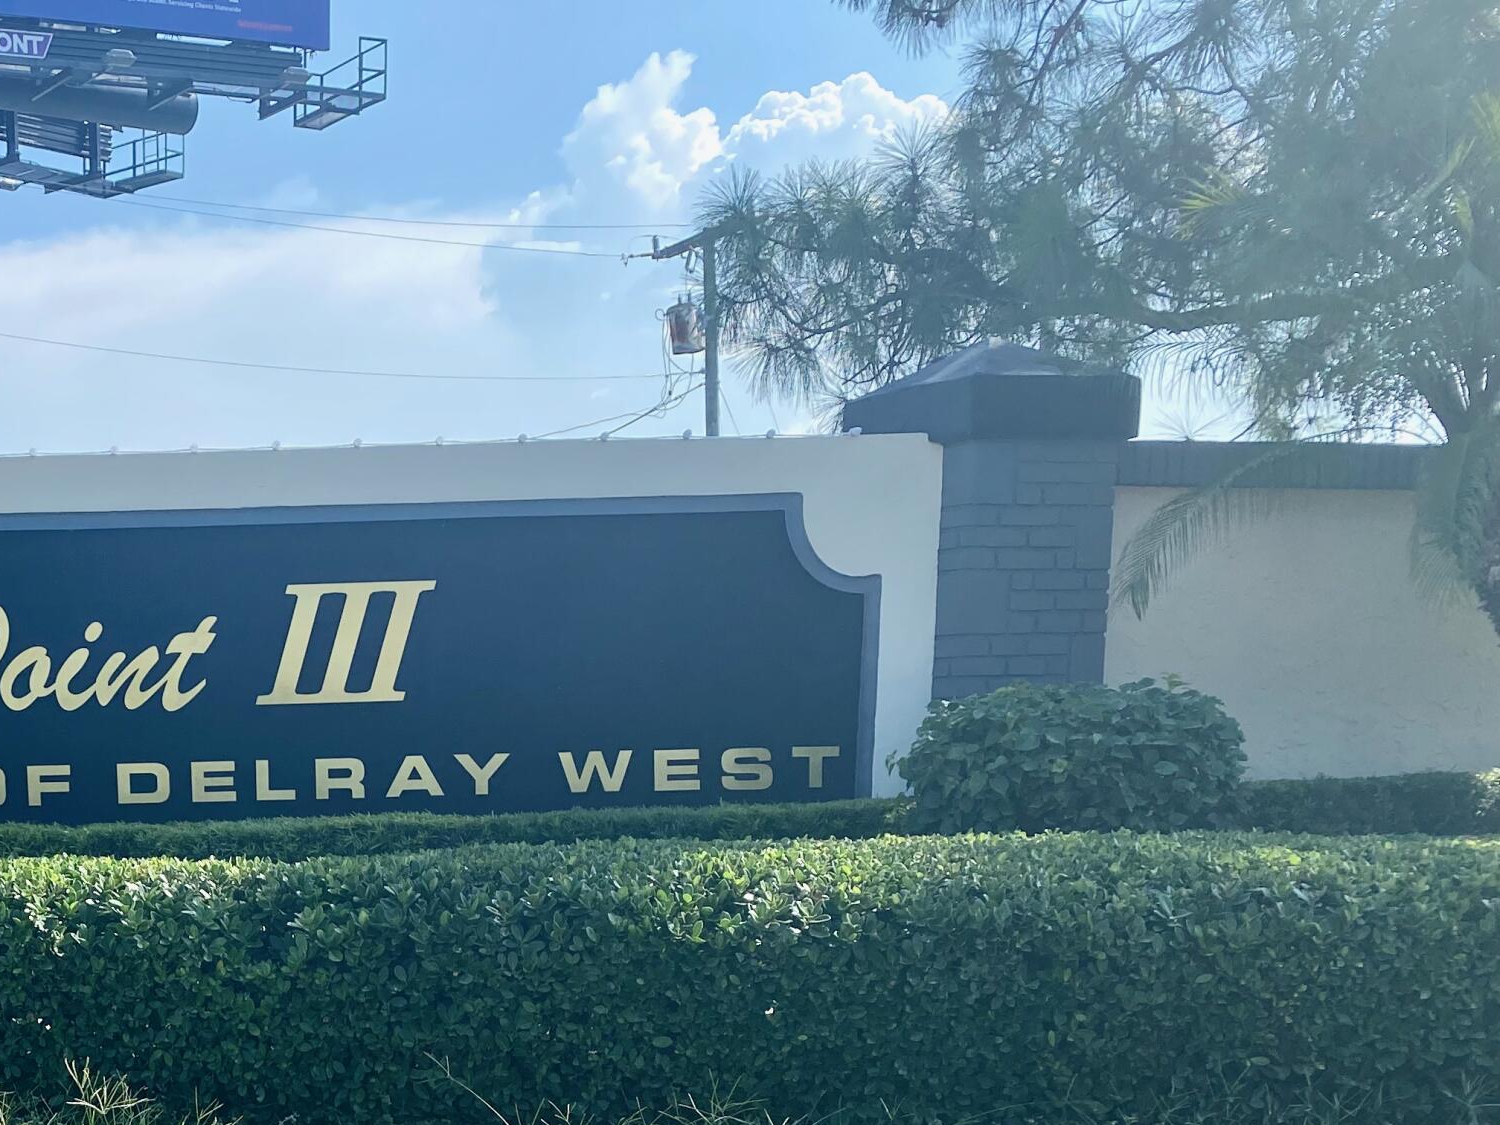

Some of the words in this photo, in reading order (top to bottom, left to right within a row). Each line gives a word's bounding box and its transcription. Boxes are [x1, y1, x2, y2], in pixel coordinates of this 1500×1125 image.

[256, 580, 437, 706] III
[116, 754, 511, 804] DELRAY
[559, 744, 842, 793] WEST
